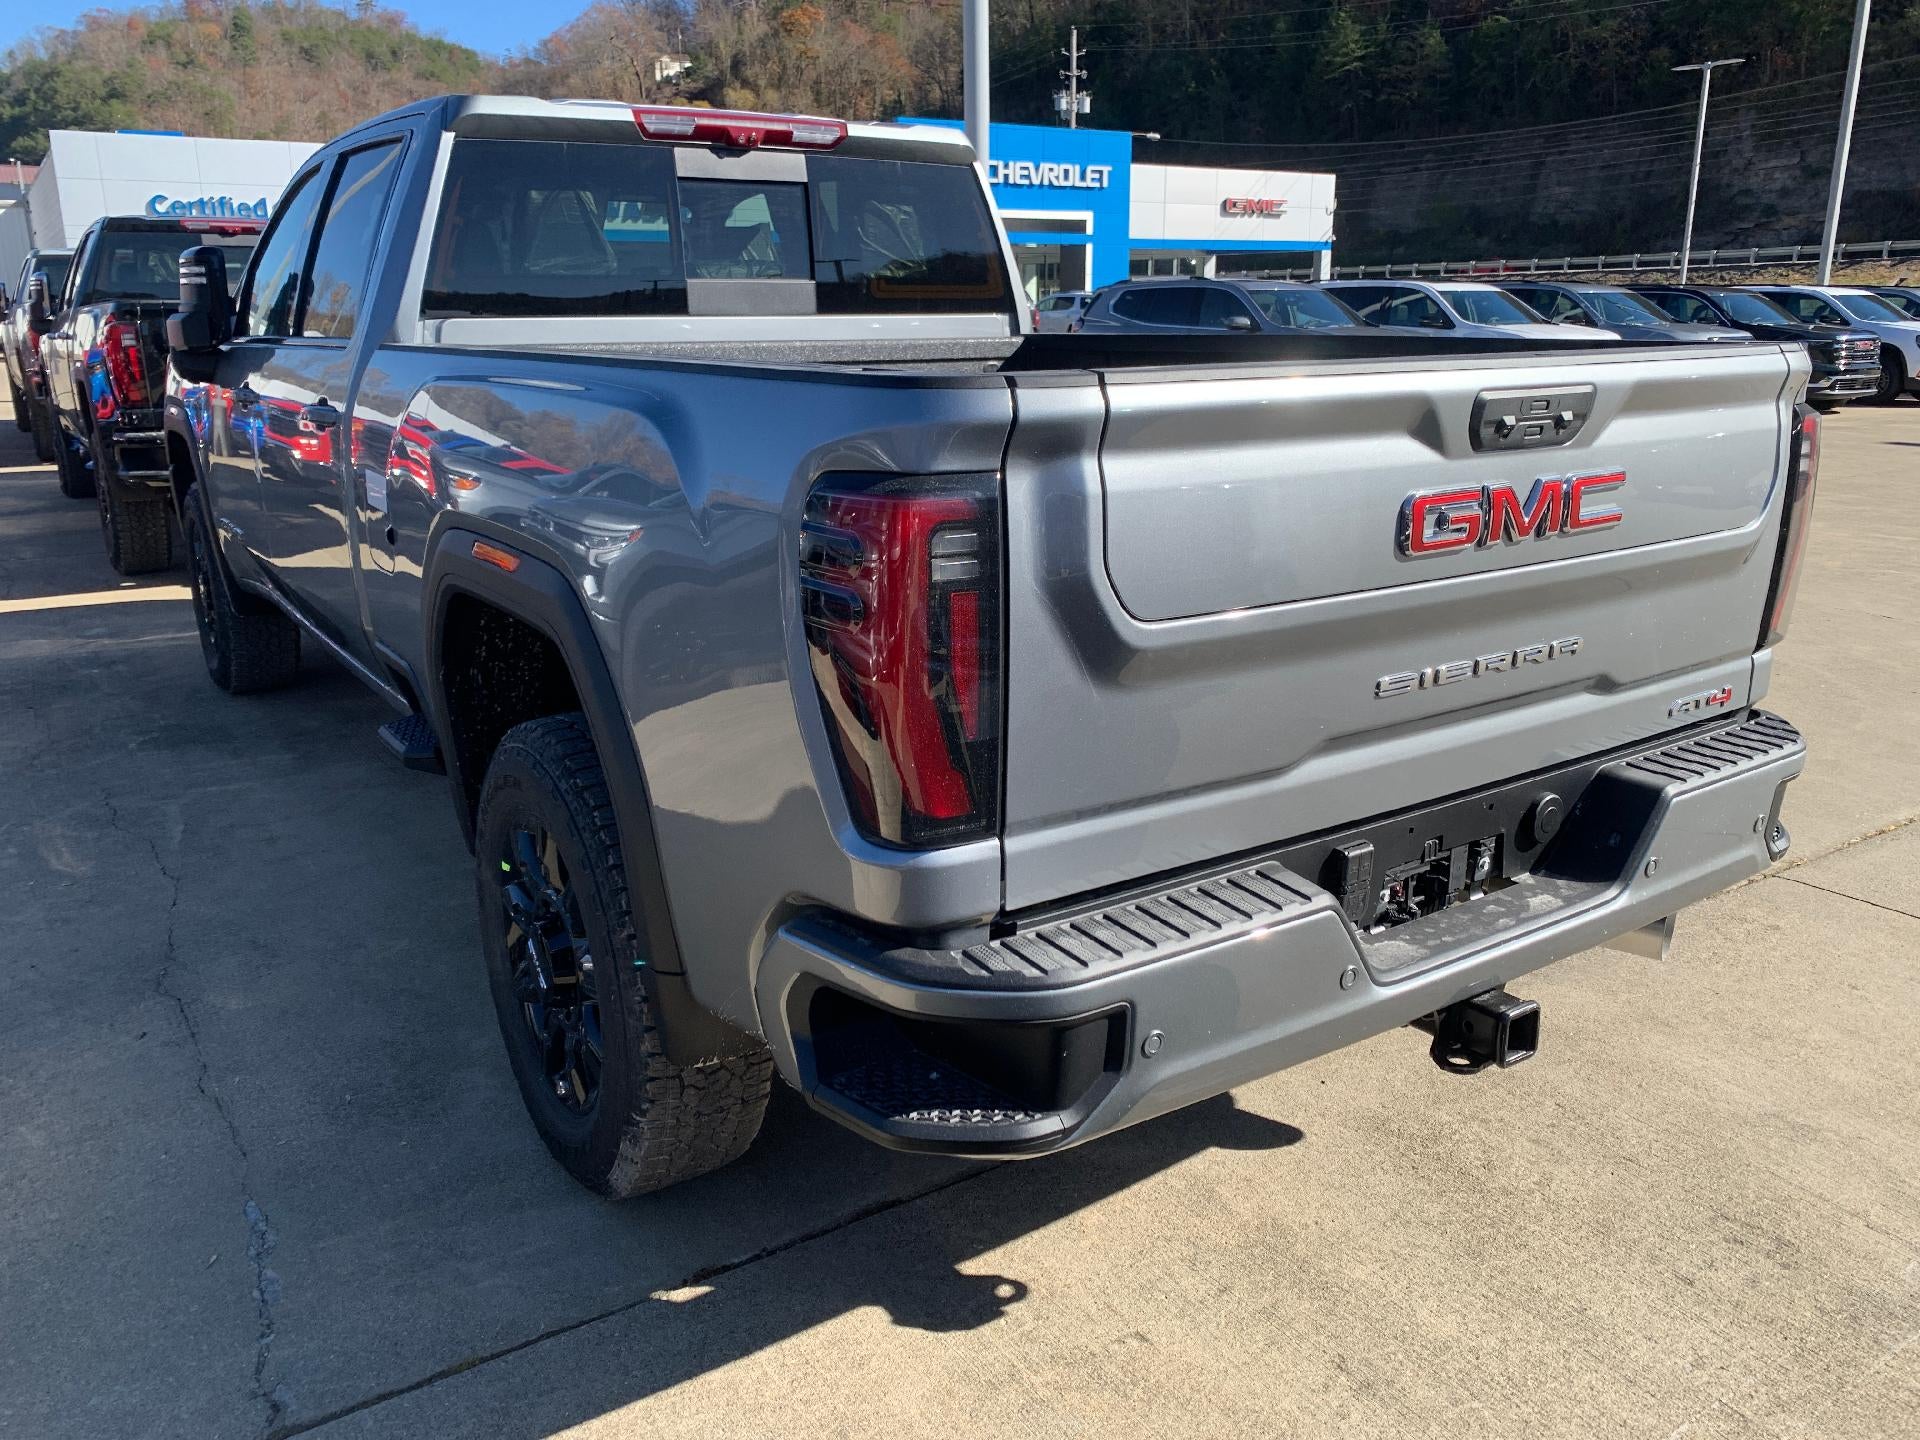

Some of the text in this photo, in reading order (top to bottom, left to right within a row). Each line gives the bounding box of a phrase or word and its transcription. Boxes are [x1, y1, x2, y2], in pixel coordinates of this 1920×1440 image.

[988, 159, 1112, 188] CHEVROLET
[147, 194, 269, 218] Certified
[1225, 198, 1288, 214] GMC
[1400, 467, 1627, 557] GMC
[1374, 636, 1584, 698] SIERRA
[1667, 684, 1733, 718] AT4
